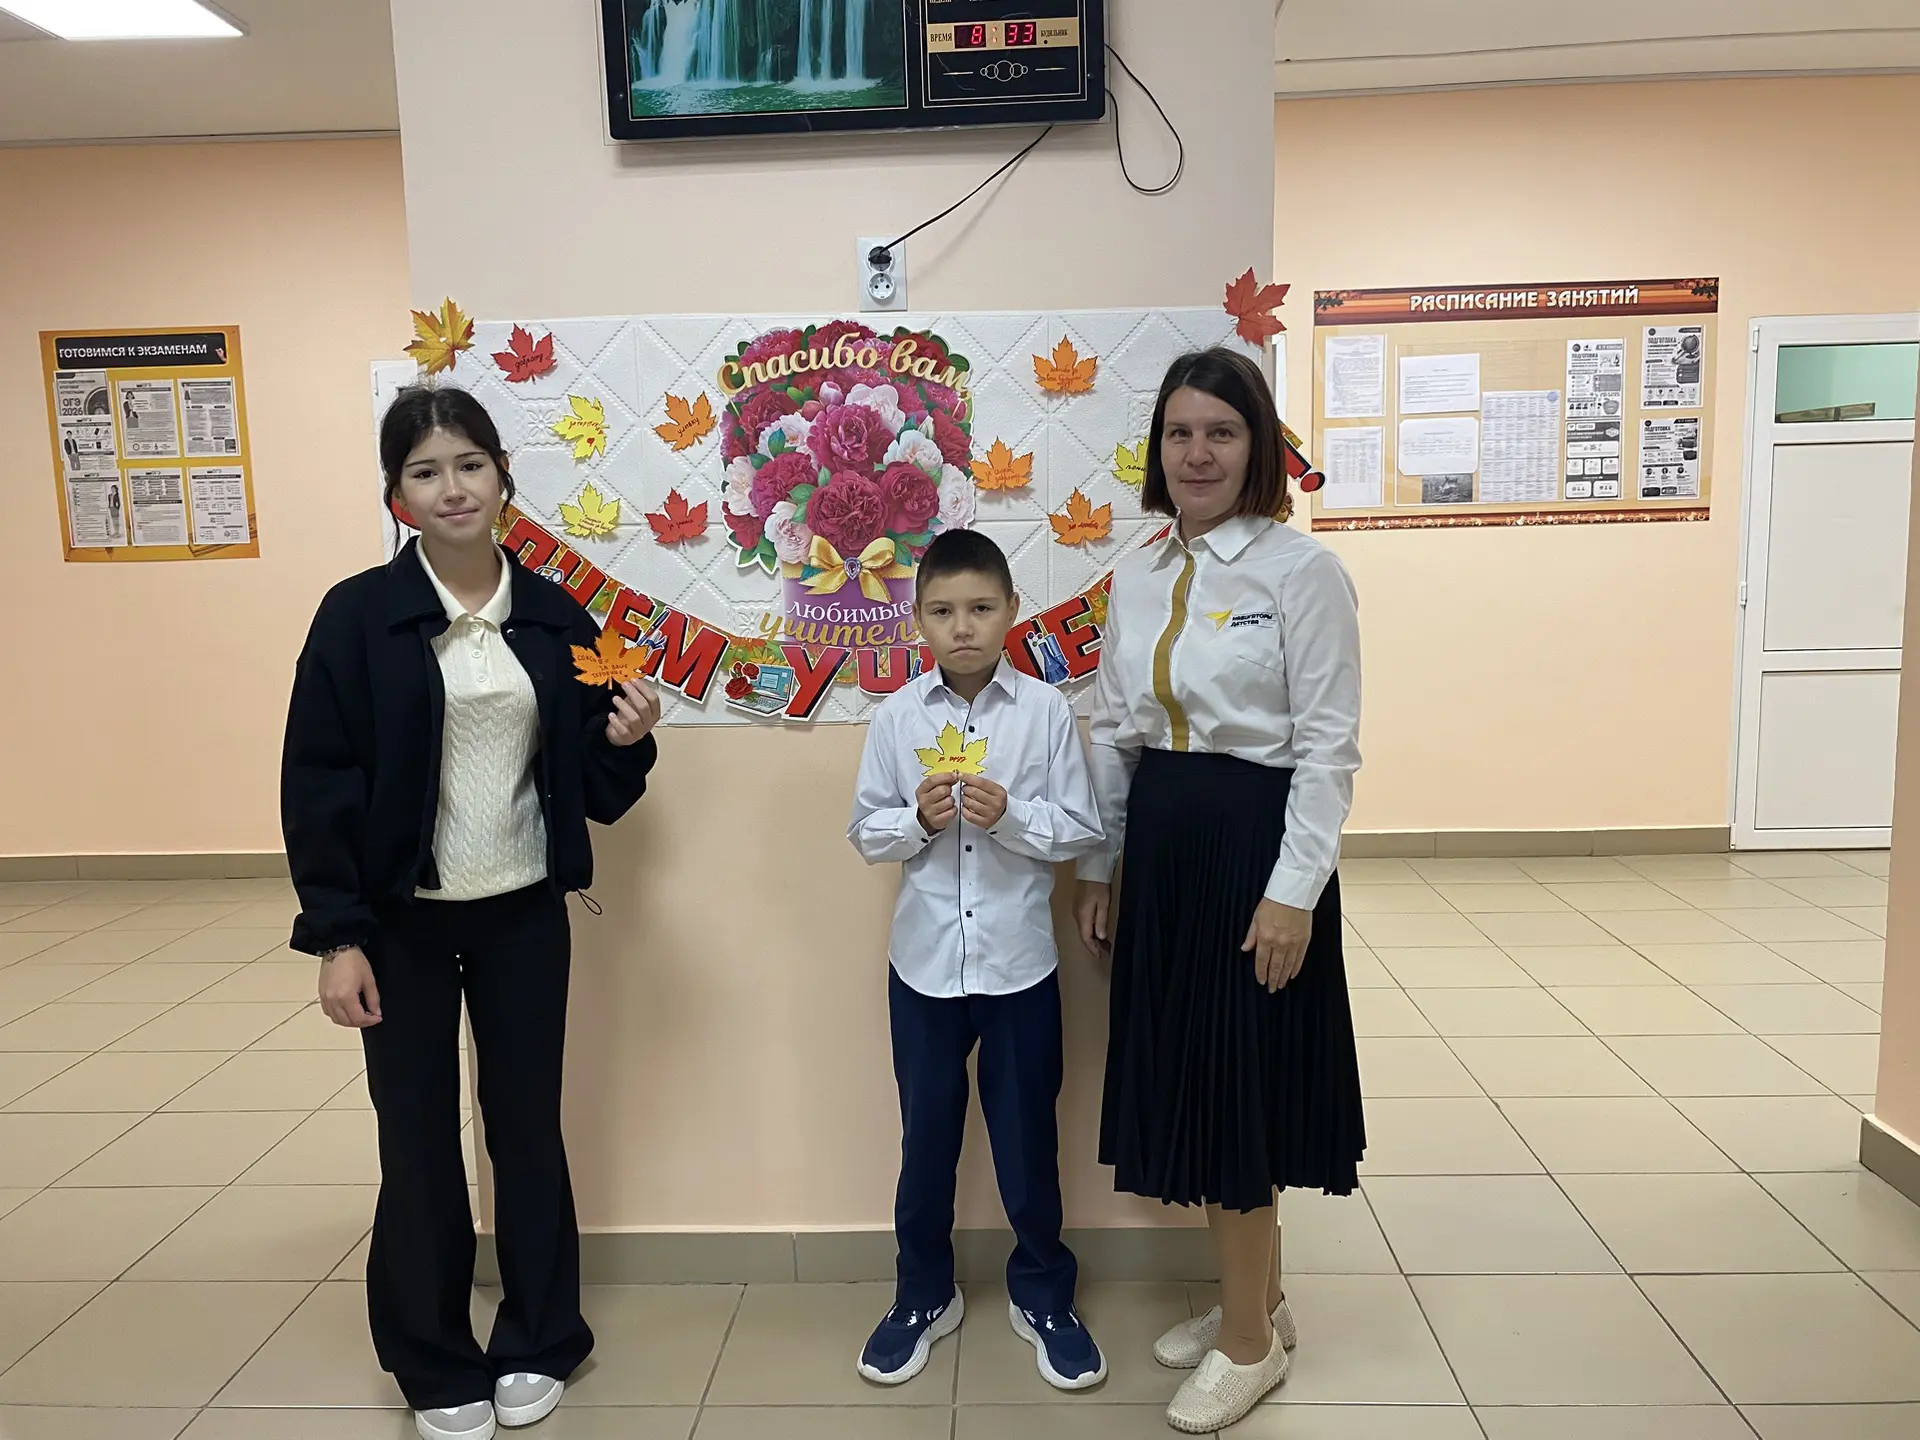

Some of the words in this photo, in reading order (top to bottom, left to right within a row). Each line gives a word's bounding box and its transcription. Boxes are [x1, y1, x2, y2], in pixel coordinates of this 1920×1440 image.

[930, 33, 952, 43] ВРЕМЯ
[1409, 291, 1538, 312] РАСПИСАНИЕ
[1546, 284, 1639, 309] ЗАНЯТИЙ
[59, 346, 126, 359] ГОТОВИМСЯ
[128, 346, 136, 357] К
[137, 343, 208, 357] ЭКЗАМЕНАМ
[717, 331, 883, 395] Спасибо
[889, 338, 974, 395] вам
[62, 398, 81, 407] ОГЭ
[62, 407, 83, 416] 2026
[786, 600, 913, 624] любимые
[759, 613, 920, 647] учител
[1230, 619, 1260, 627] ДЕТСТВА
